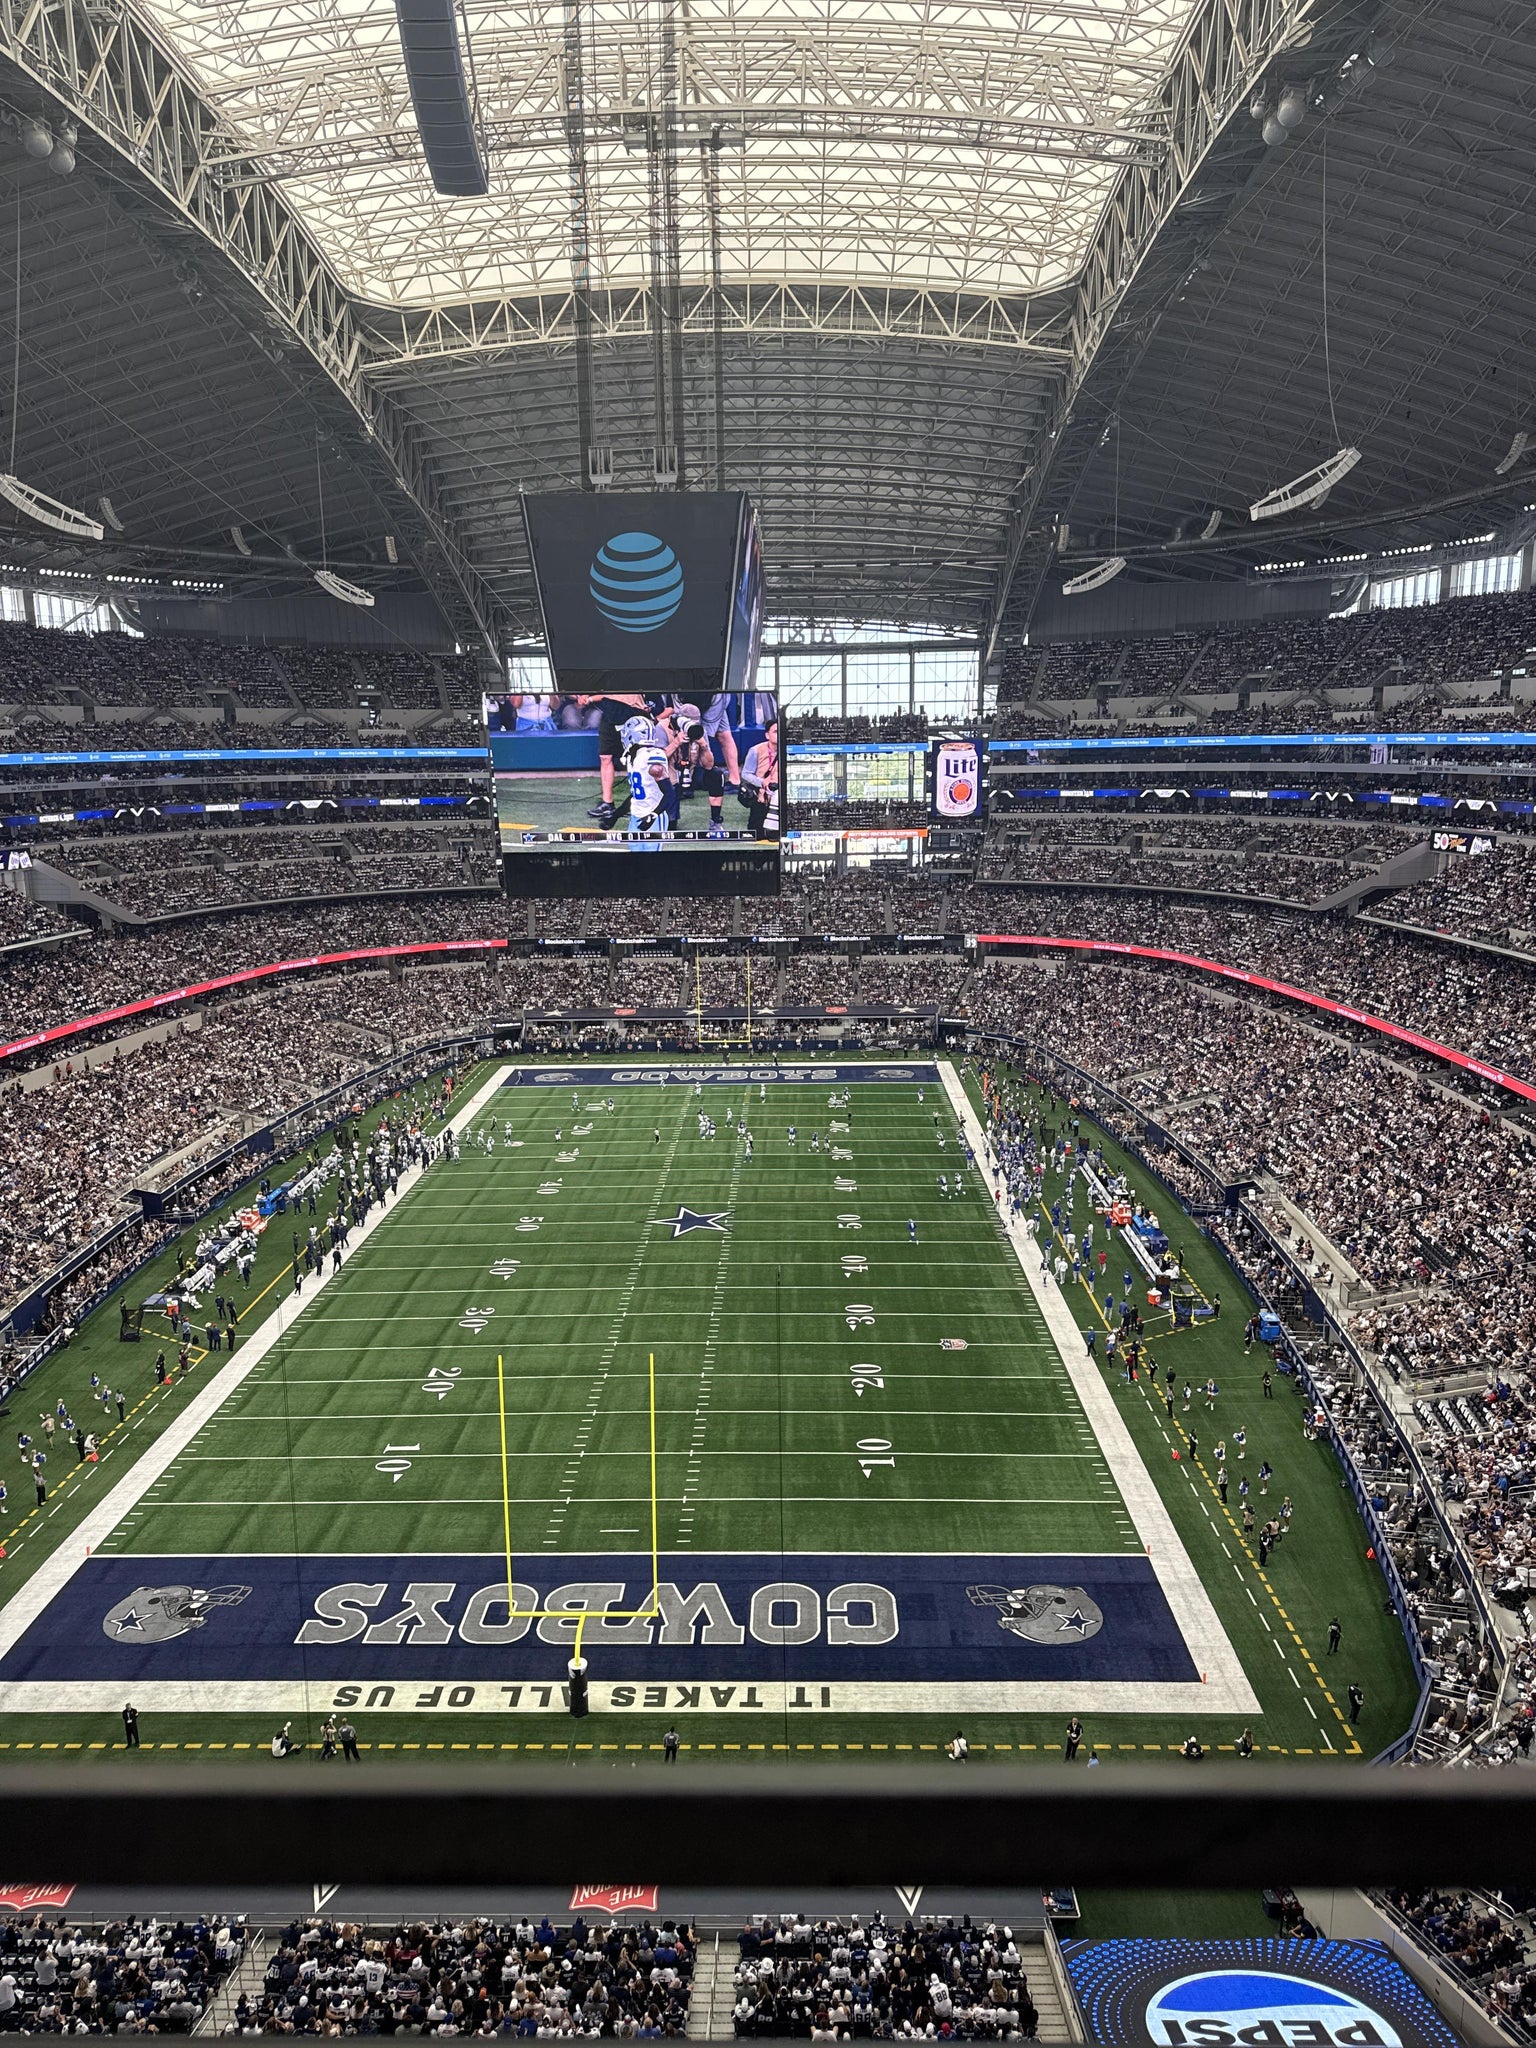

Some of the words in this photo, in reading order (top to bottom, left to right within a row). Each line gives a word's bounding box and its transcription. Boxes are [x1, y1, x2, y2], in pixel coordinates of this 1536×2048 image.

[945, 759, 976, 778] Lite
[548, 833, 564, 842] DAL
[570, 833, 575, 842] 0
[607, 832, 622, 842] NYG
[628, 832, 633, 842] 0
[966, 937, 977, 948] 39
[612, 1070, 837, 1082] COWBOYS
[571, 1123, 592, 1135] 20
[829, 1122, 850, 1132] 20
[555, 1151, 579, 1162] 30
[832, 1149, 853, 1160] 30
[536, 1181, 563, 1195] 40
[834, 1179, 857, 1192] 40
[515, 1216, 544, 1232] 50
[836, 1214, 862, 1229] 50
[489, 1257, 521, 1275] 40
[840, 1255, 869, 1273] 40
[459, 1307, 495, 1328] 30
[845, 1304, 876, 1325] 30
[421, 1367, 462, 1392] 20
[850, 1363, 885, 1389] 20
[375, 1442, 421, 1473] 10
[856, 1438, 896, 1468] 10
[293, 1583, 899, 1645] COWBOYS
[332, 1686, 396, 1708] US
[415, 1686, 476, 1708] OF
[610, 1686, 764, 1708] TAKES
[789, 1686, 831, 1708] IT
[22, 1882, 63, 1903] THE
[588, 1885, 644, 1906] THE
[369, 1972, 378, 1982] 13
[935, 1990, 948, 2003] 88
[1161, 2018, 1388, 2047] PEPSI
